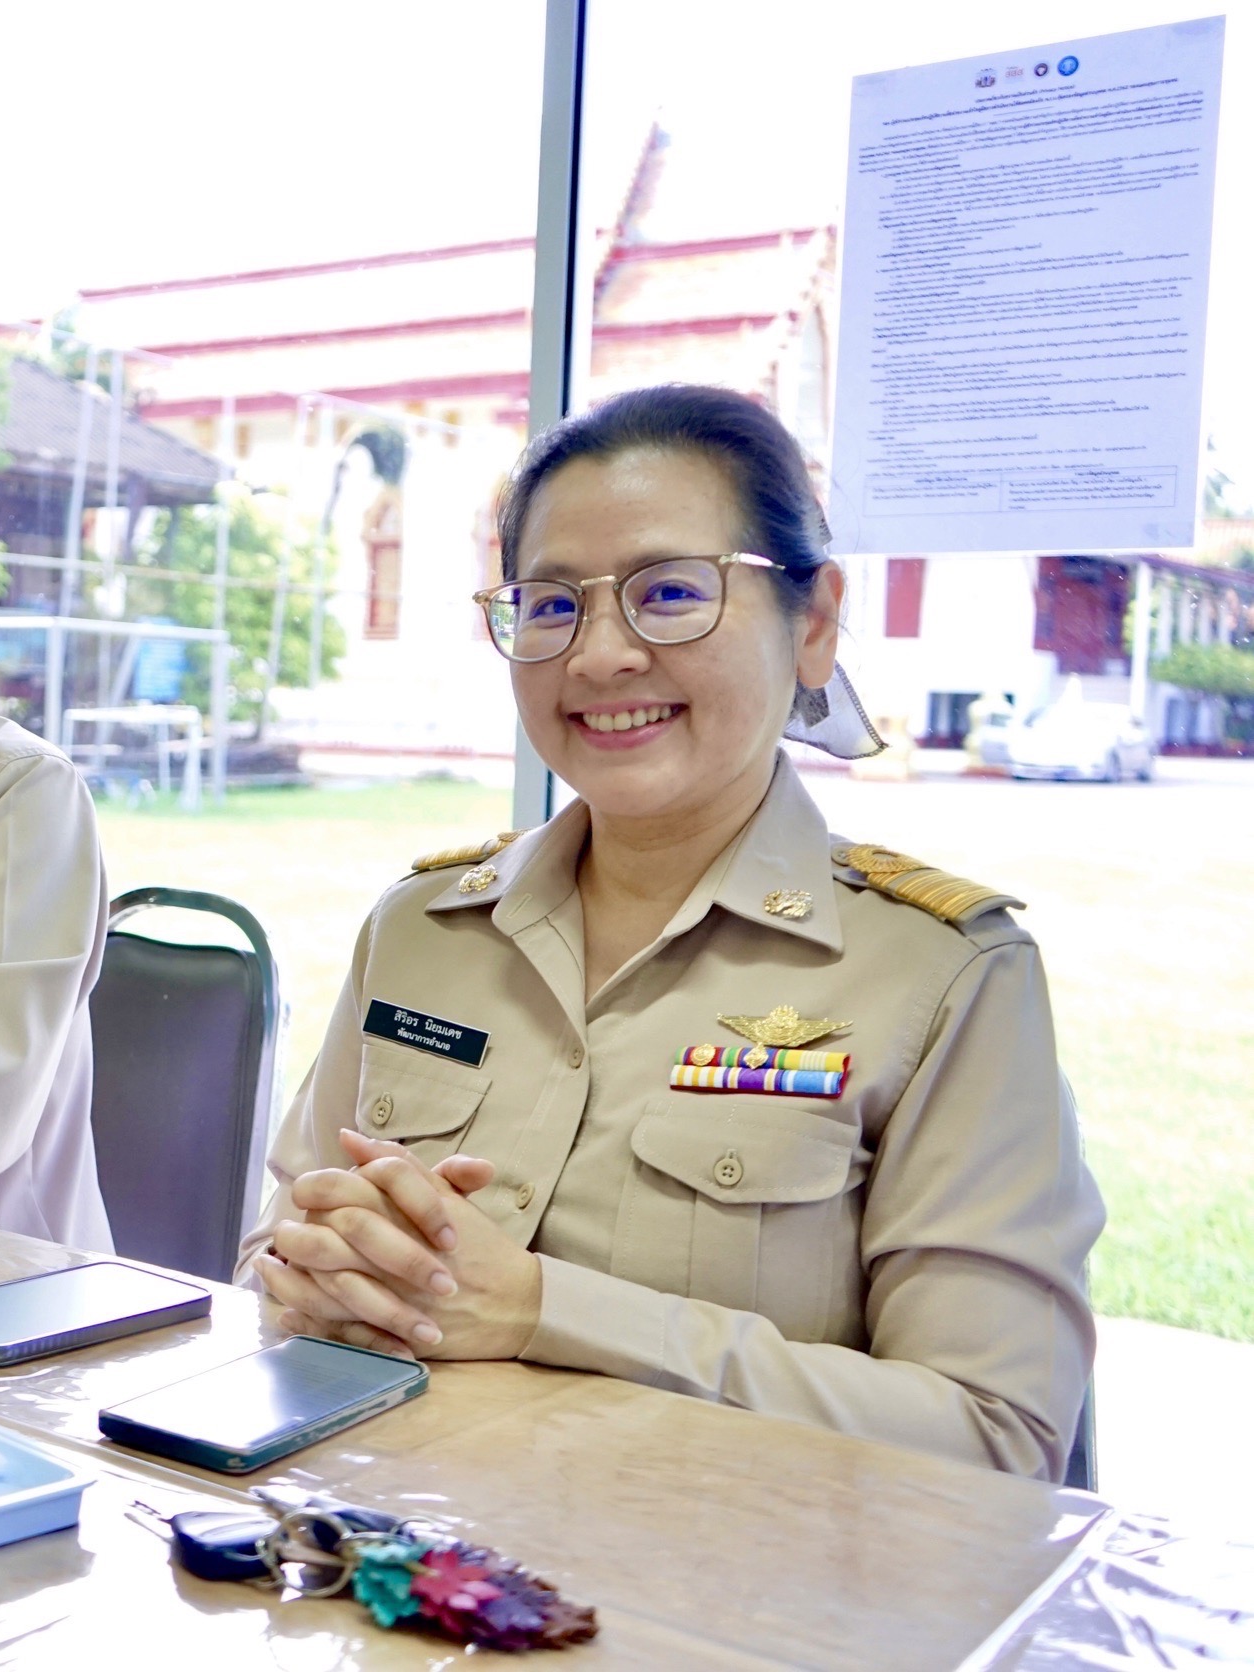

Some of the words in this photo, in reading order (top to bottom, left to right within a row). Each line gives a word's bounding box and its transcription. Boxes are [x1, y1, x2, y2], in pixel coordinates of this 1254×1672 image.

[394, 1010, 419, 1027] สิริอร
[425, 1019, 463, 1040] นิยมเดช
[397, 1027, 451, 1051] พัฒนาการอำเภอ
